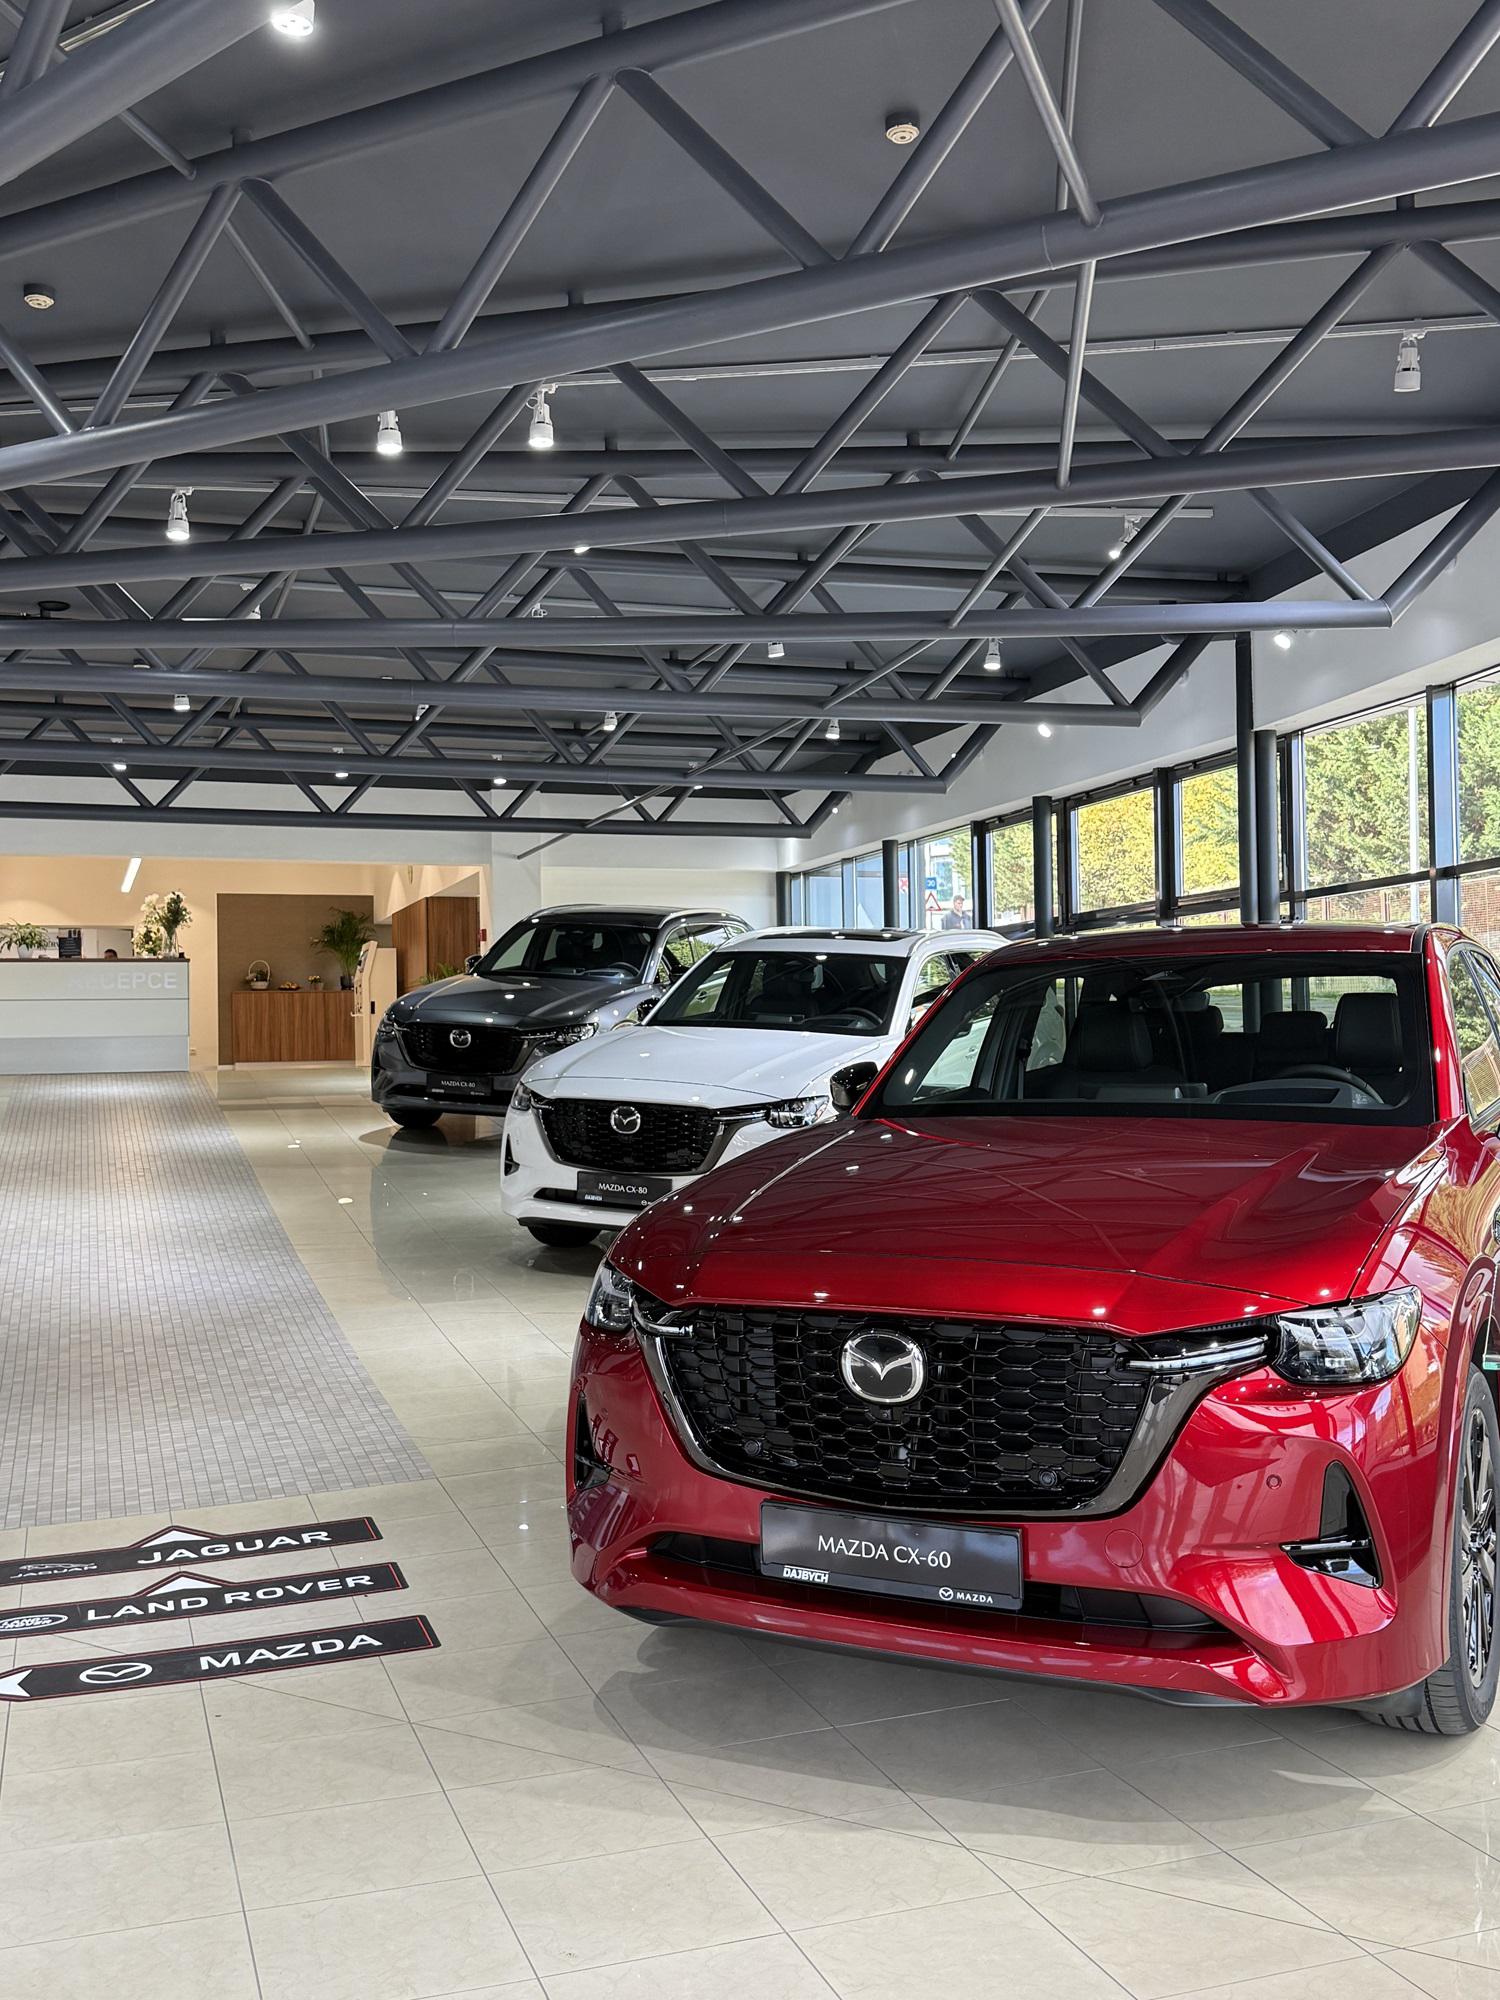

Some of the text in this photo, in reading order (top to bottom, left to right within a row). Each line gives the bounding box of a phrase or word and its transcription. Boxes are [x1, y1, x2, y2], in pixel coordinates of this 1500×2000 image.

[68, 972, 178, 989] CEPCE
[598, 1183, 648, 1194] MAZDA CX-80
[137, 1530, 332, 1565] JAGUAR
[818, 1535, 951, 1569] MAZDA CX-60
[783, 1565, 830, 1584] DAJBYCH
[87, 1574, 375, 1621] LAND ROVER
[956, 1592, 994, 1604] MAZDA
[199, 1633, 383, 1671] MAZDA
